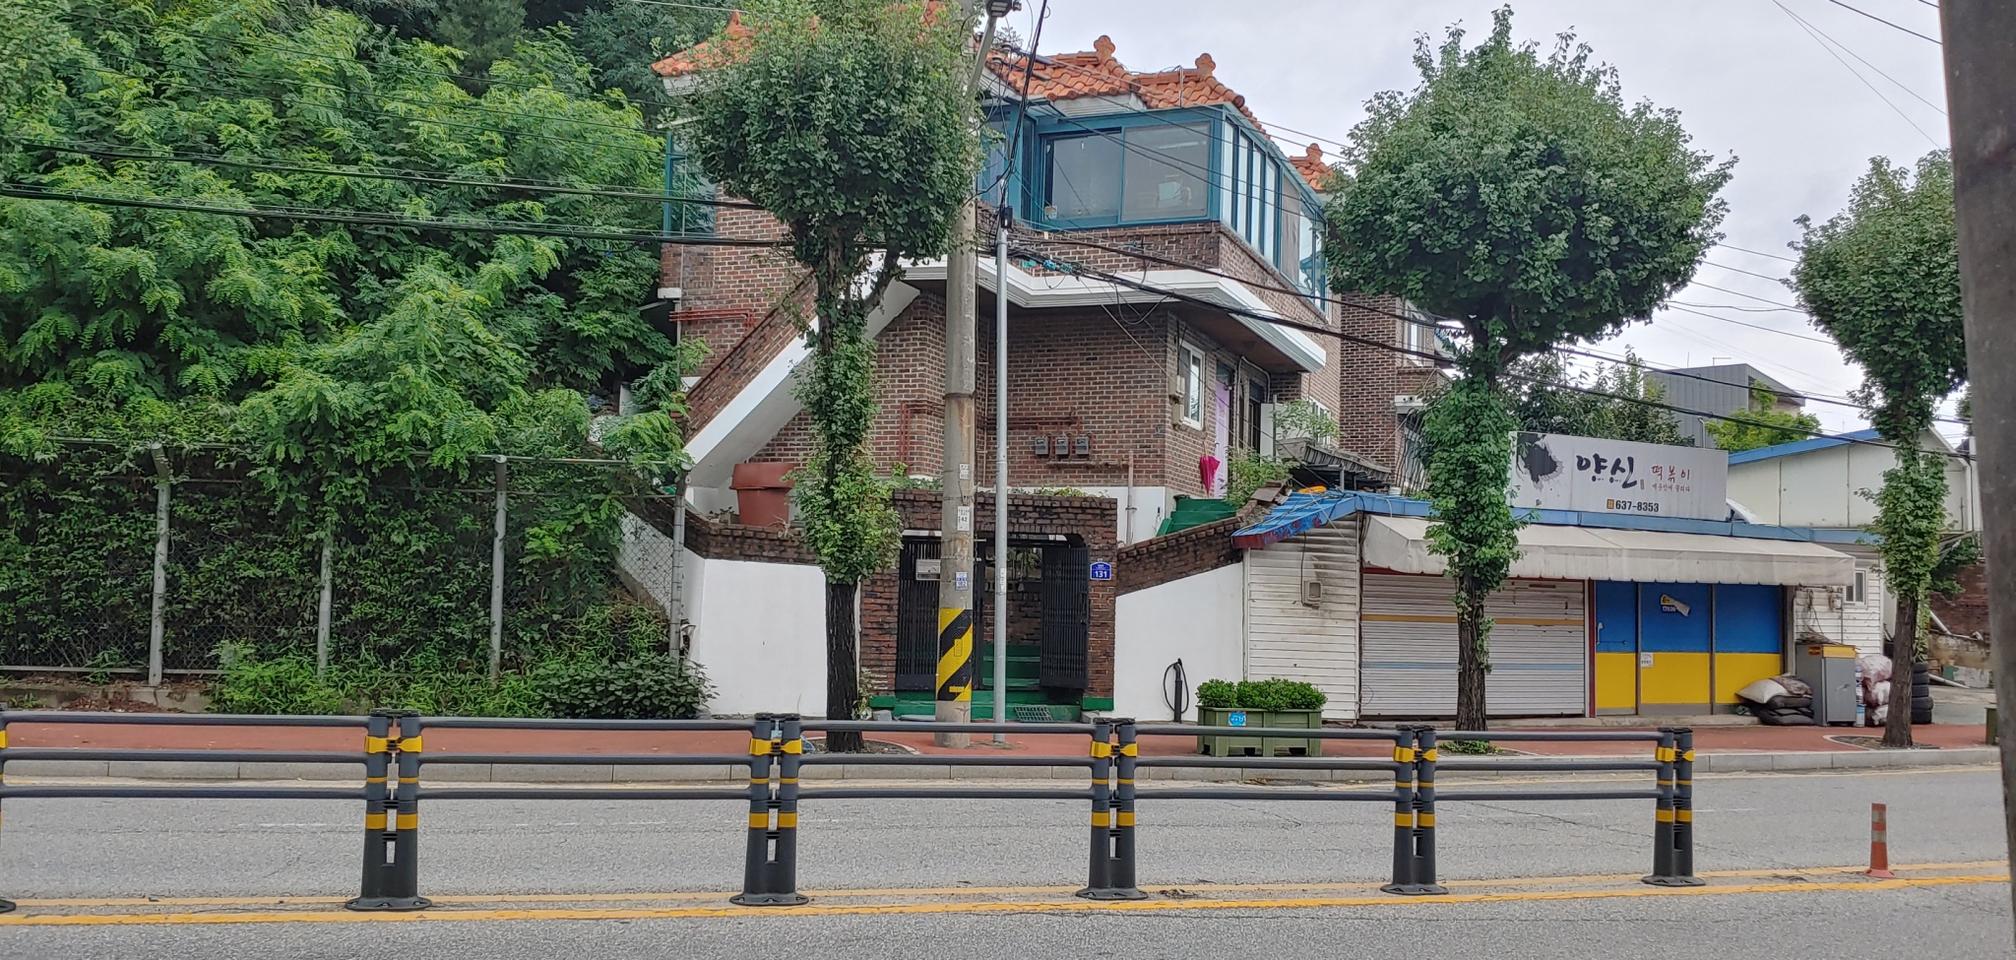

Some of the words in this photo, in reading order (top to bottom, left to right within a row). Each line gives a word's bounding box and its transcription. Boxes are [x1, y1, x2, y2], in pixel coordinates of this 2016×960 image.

[1576, 453, 1637, 488] 양신
[1651, 465, 1690, 483] 떡볶이
[1616, 500, 1659, 512] 637-8353
